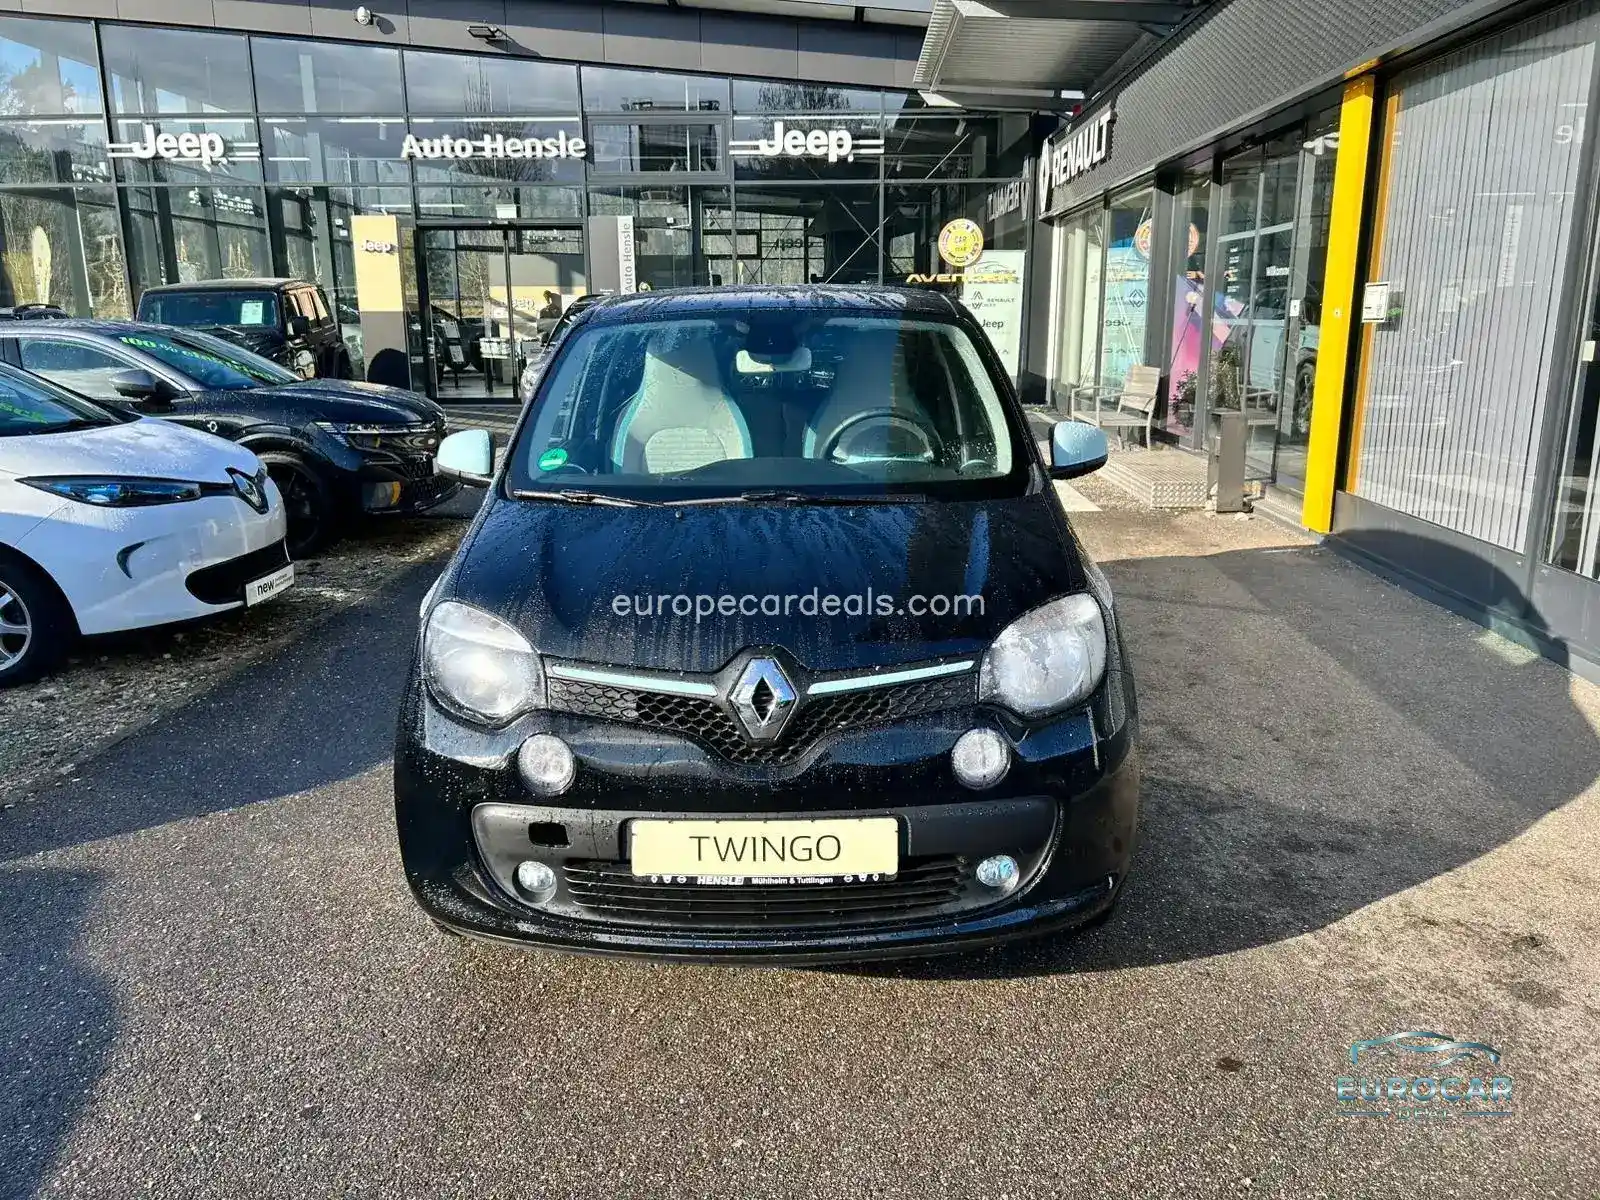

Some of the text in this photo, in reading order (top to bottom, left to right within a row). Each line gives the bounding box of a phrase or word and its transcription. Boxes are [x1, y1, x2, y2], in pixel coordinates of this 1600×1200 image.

[131, 123, 225, 168] Jeep
[401, 130, 587, 158] Auto Hensle
[758, 121, 853, 162] Jeep
[1052, 110, 1111, 189] RENAULT
[621, 223, 633, 293] Auto Hensle
[257, 579, 275, 596] new
[689, 834, 842, 862] TWINGO
